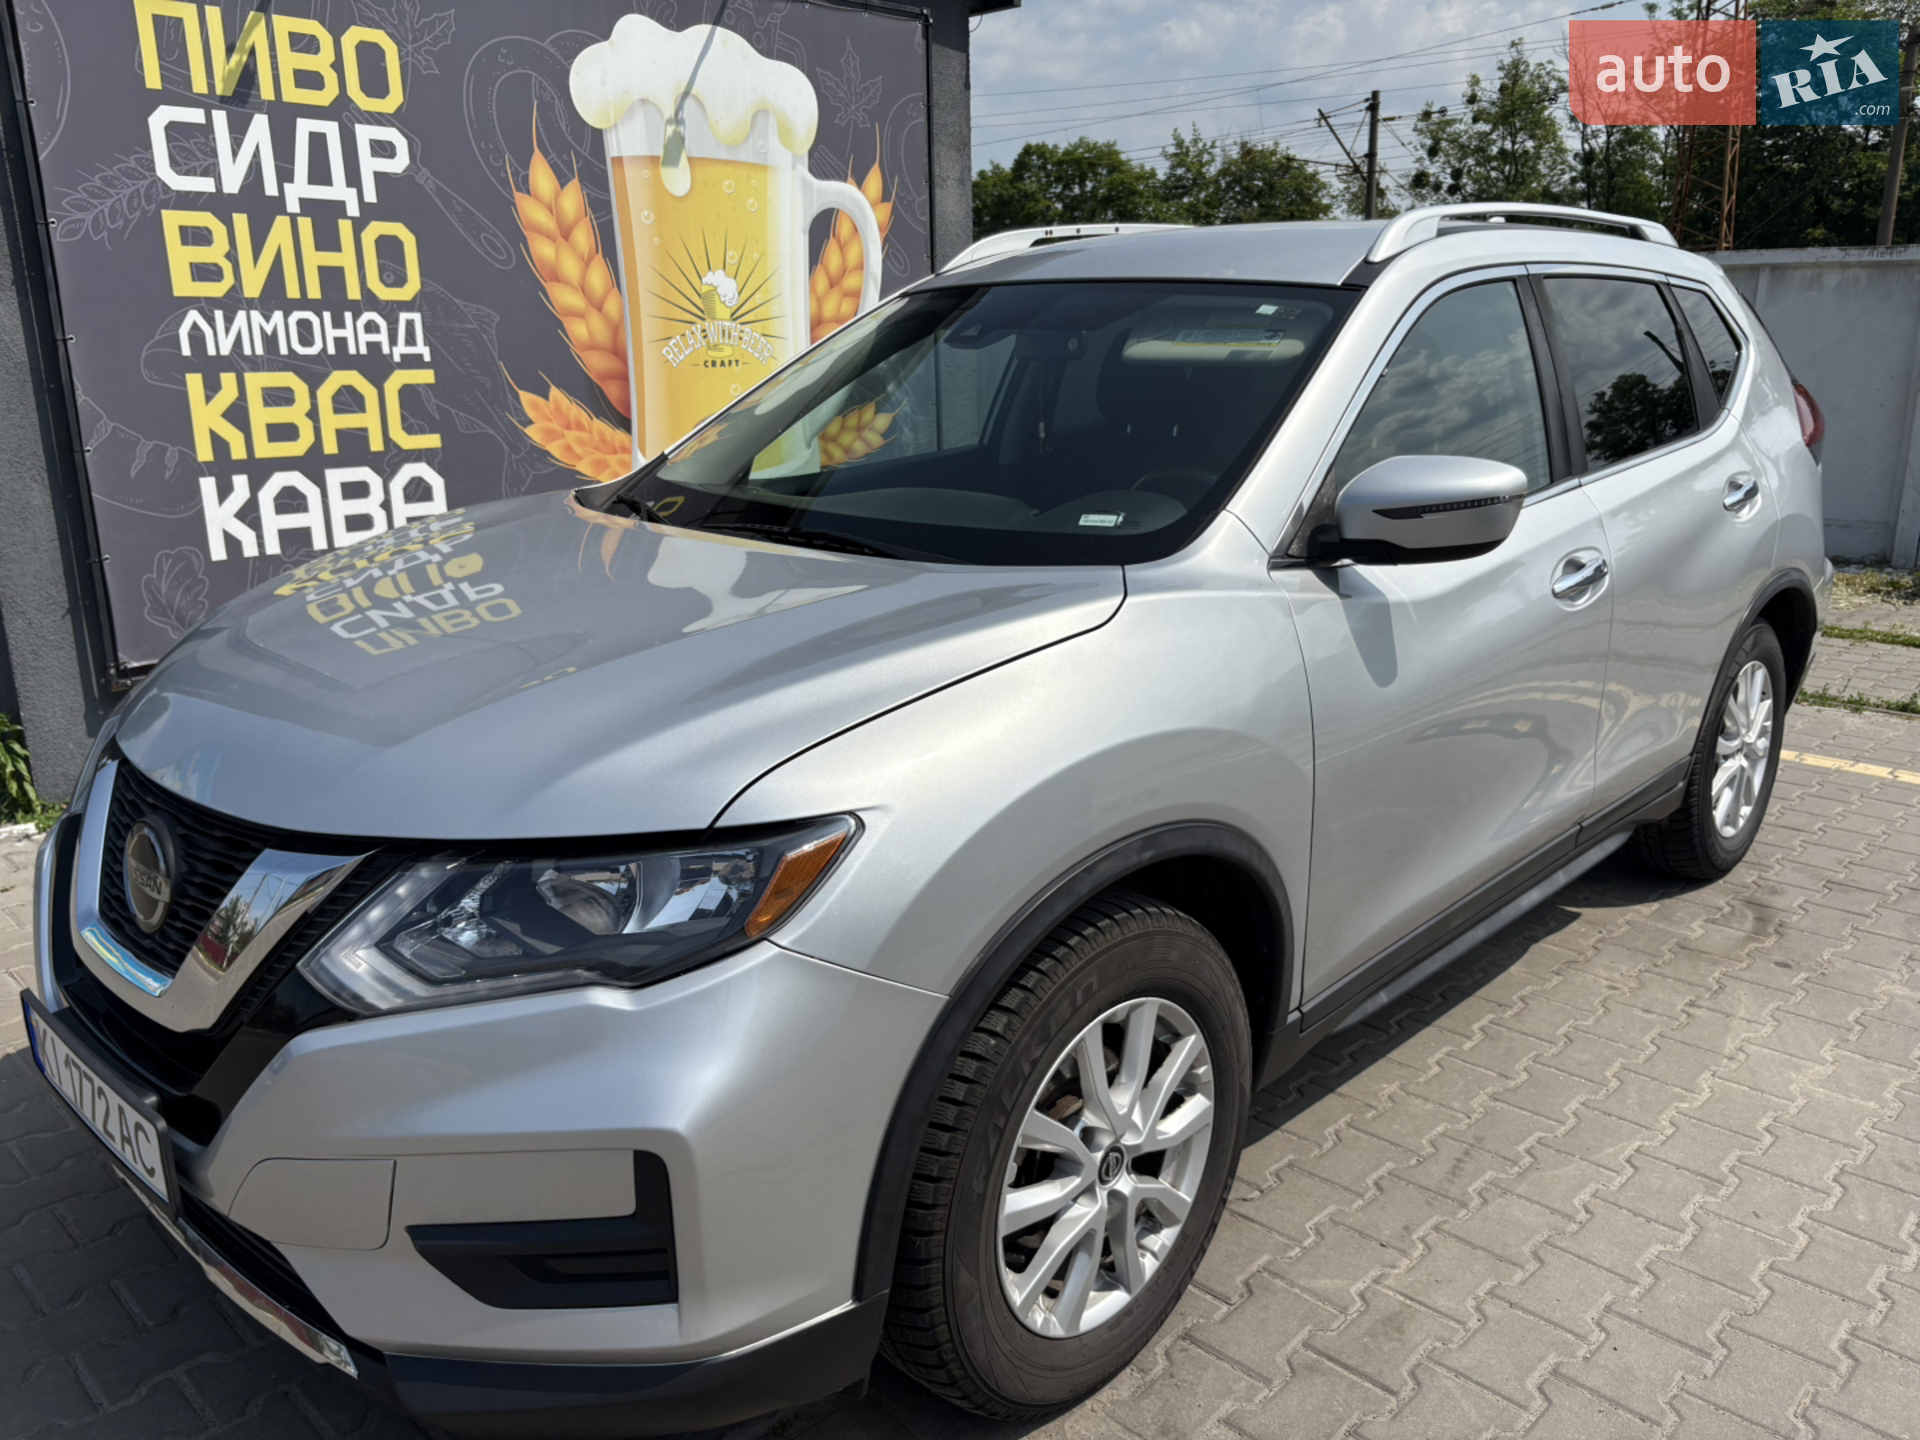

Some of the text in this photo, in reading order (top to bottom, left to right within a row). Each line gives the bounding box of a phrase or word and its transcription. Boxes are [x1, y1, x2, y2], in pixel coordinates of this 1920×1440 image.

[133, 0, 404, 114] ПИВО
[147, 104, 410, 217] СИДР
[160, 209, 421, 300] ВИНО
[178, 309, 431, 362] ЛИМОНАД
[661, 321, 774, 368] RELAX WITH BEER
[703, 359, 741, 368] CRAFT
[185, 369, 442, 462] КВАС
[199, 462, 448, 562] КАВА
[64, 1053, 117, 1144] 1772
[117, 1103, 156, 1178] AC
